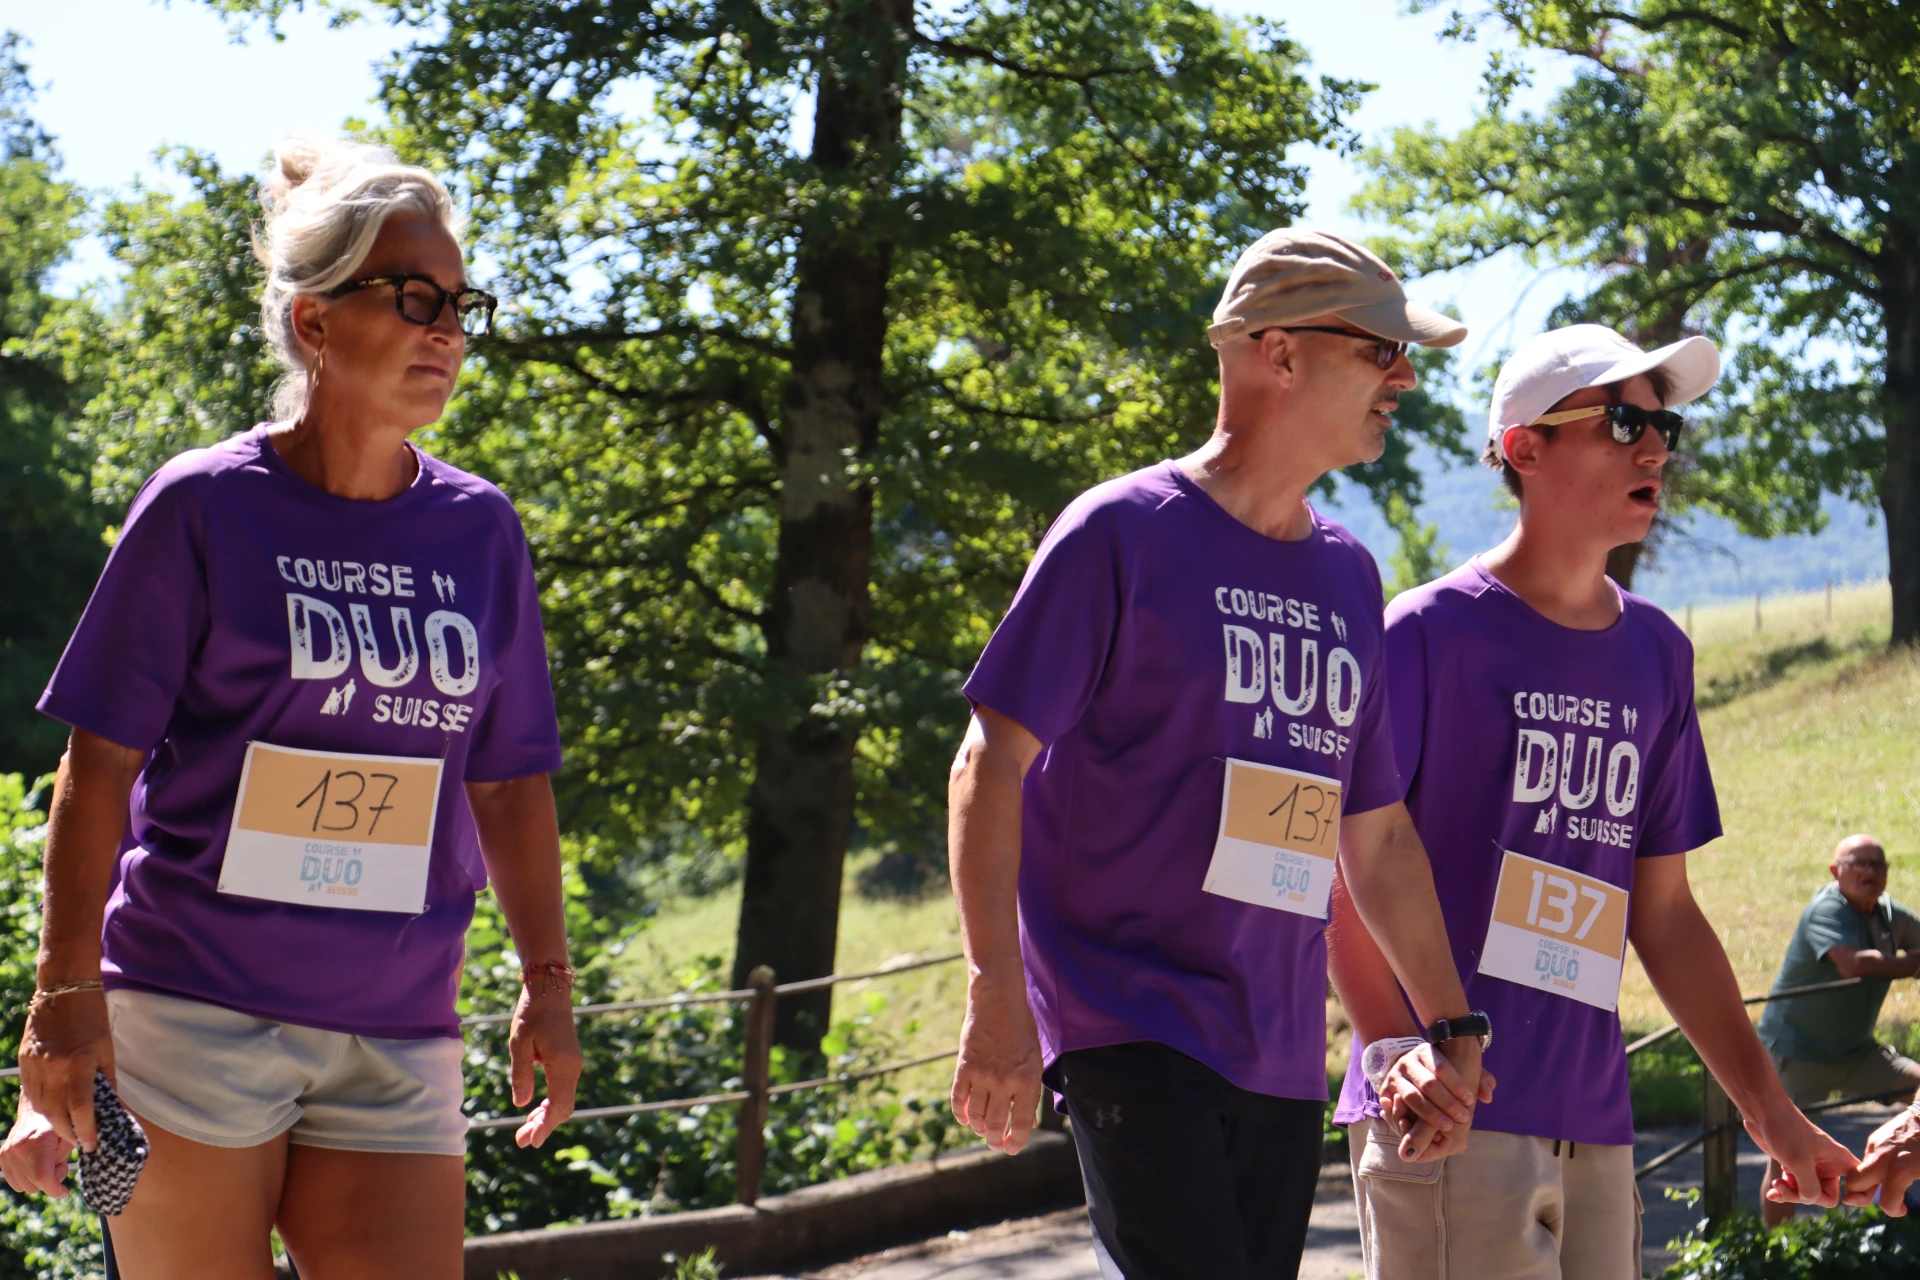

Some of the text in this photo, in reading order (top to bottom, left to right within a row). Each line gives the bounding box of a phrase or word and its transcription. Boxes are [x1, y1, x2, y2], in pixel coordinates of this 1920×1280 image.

[277, 555, 415, 597] COURSE
[1215, 586, 1321, 632] COURSE
[286, 592, 479, 697] DUO
[1223, 623, 1361, 727] DUO
[372, 694, 473, 732] SUISSE
[1513, 691, 1611, 729] COURSE
[1512, 728, 1640, 817] DUO
[296, 769, 398, 836] 137
[1268, 783, 1338, 845] 137
[304, 843, 348, 856] COURSE
[1567, 815, 1633, 849] SUISSE
[300, 855, 362, 886] DUO
[1271, 863, 1310, 893] DUO
[1526, 869, 1607, 940] 137
[1535, 950, 1580, 981] DUO
[1539, 939, 1569, 955] COURSE
